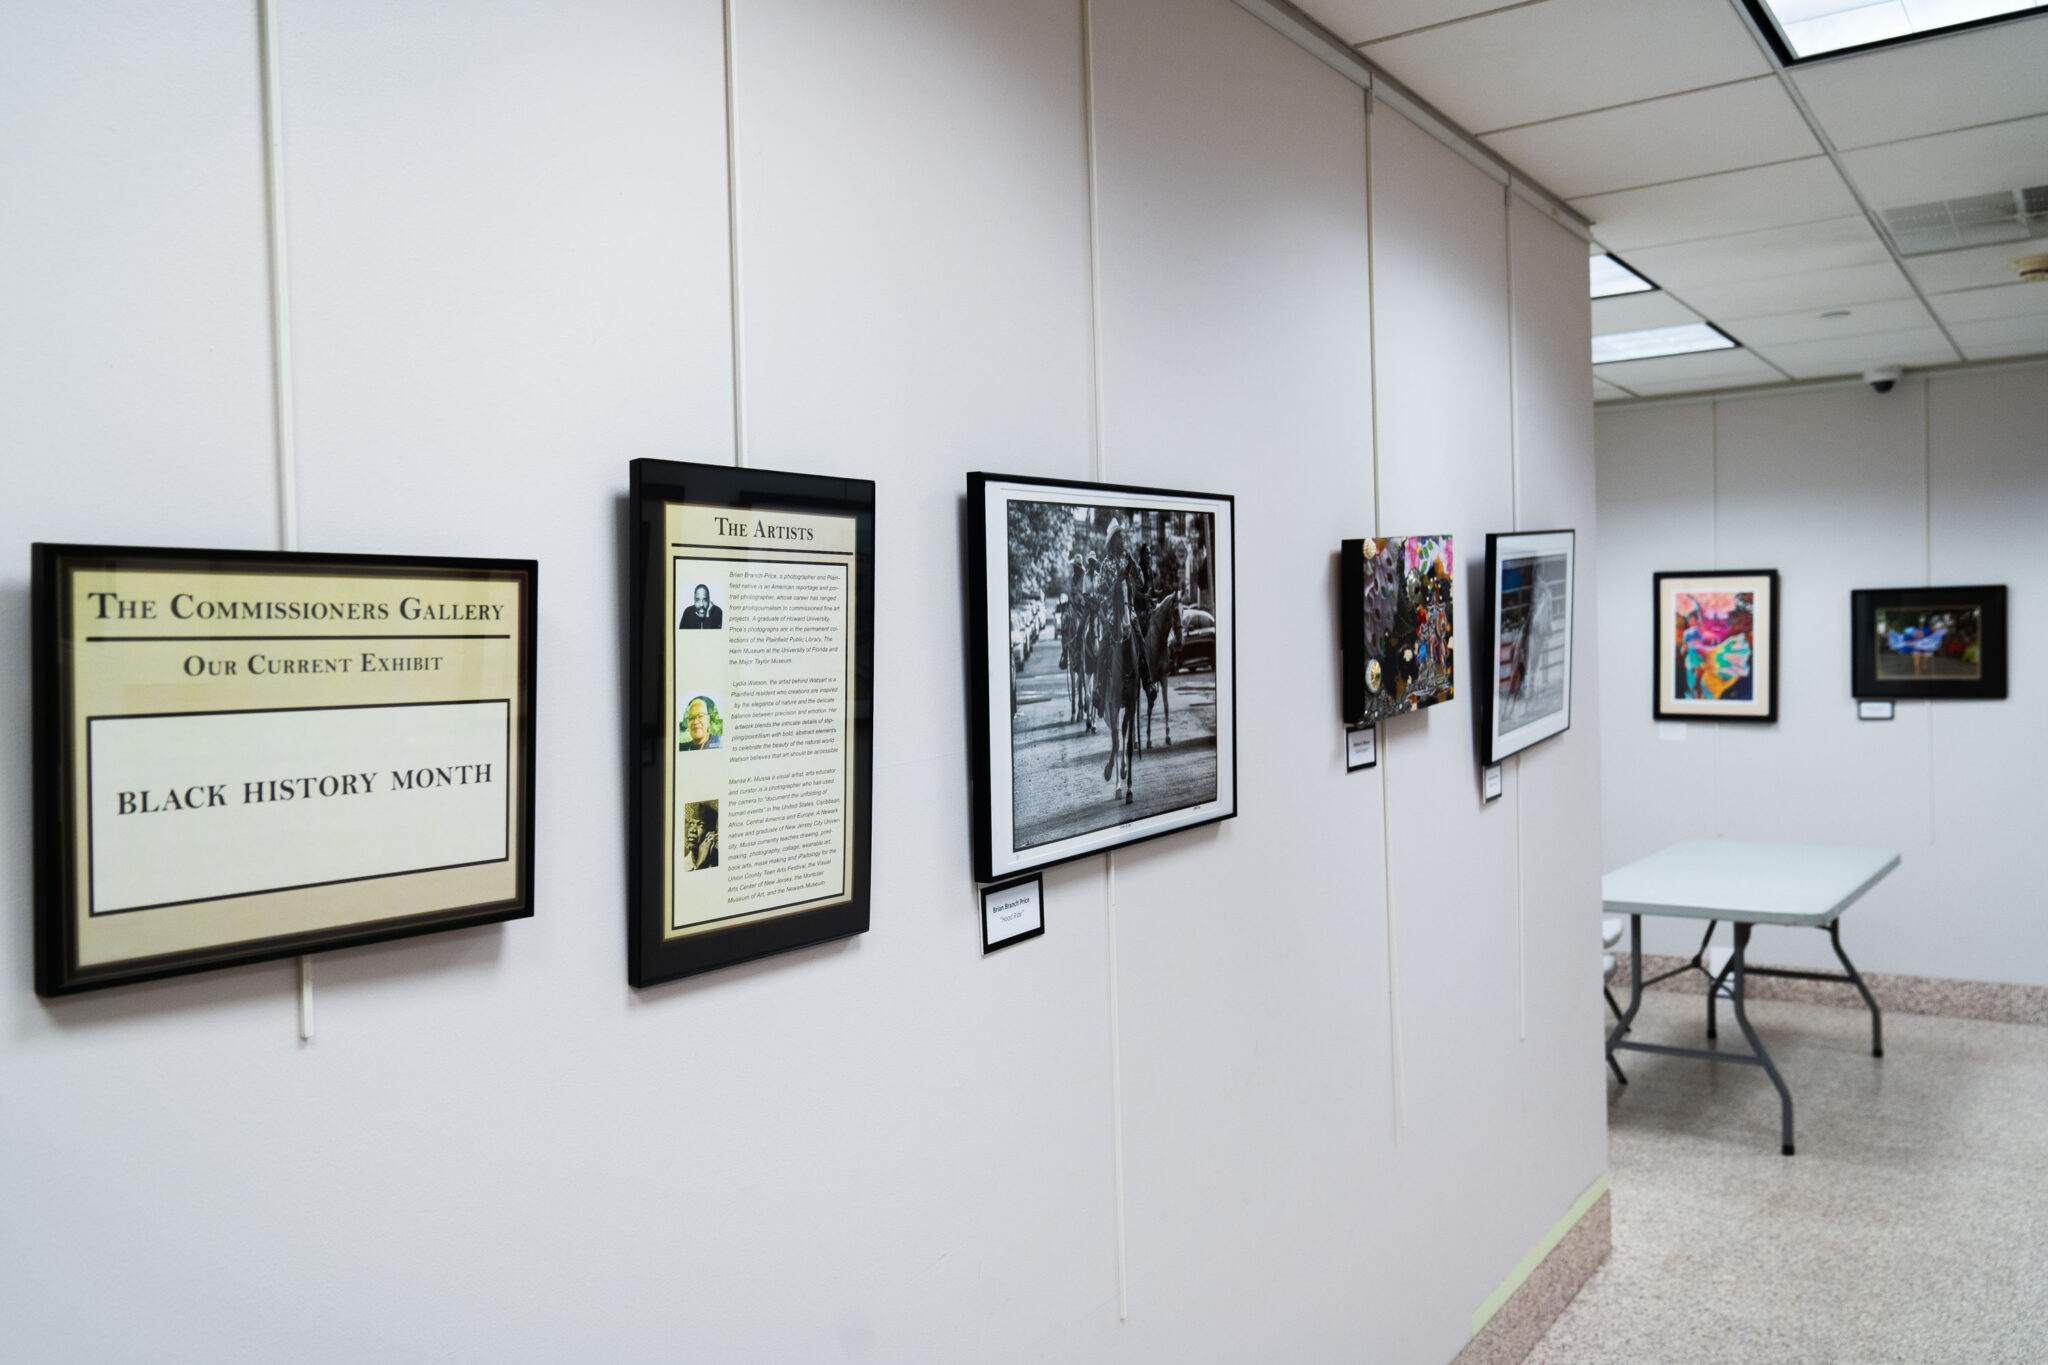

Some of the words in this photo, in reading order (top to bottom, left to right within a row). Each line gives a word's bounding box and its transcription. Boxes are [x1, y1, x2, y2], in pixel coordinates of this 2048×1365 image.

[714, 516, 747, 537] THE
[753, 519, 814, 541] ARTISTS
[784, 573, 816, 581] photographer
[796, 584, 818, 592] reportage
[86, 591, 157, 620] THE
[170, 593, 389, 620] COMMISSIONERS
[399, 596, 503, 621] GALLERY
[183, 655, 237, 677] OUR
[247, 654, 350, 676] CURRENT
[361, 652, 442, 672] EXHIBIT
[775, 709, 797, 718] precision
[739, 743, 762, 751] celebrate
[773, 741, 789, 749] beauty
[750, 753, 770, 761] believes
[118, 784, 227, 816] BLACK
[243, 772, 377, 804] HISTORY
[391, 763, 492, 790] MONTH
[769, 782, 801, 792] photographer
[728, 809, 746, 817] human
[746, 817, 764, 826] Central
[765, 815, 785, 823] America
[728, 831, 744, 839] native
[756, 826, 777, 836] graduate
[797, 821, 813, 830] Jersey
[814, 820, 823, 828] City
[740, 840, 756, 848] Mussa
[757, 836, 779, 847] currently
[780, 833, 799, 842] teaches
[802, 840, 823, 849] wearable
[769, 856, 786, 866] making
[728, 874, 743, 882] Union
[745, 870, 762, 880] County
[764, 868, 775, 876] Teen
[728, 885, 739, 893] Arts
[740, 882, 756, 891] Center
[803, 870, 824, 879] Montclair
[728, 894, 749, 904] Museum
[786, 884, 804, 893] Newark
[992, 905, 1005, 914] Brian
[1004, 900, 1020, 910] Branch
[1019, 897, 1030, 905] Price
